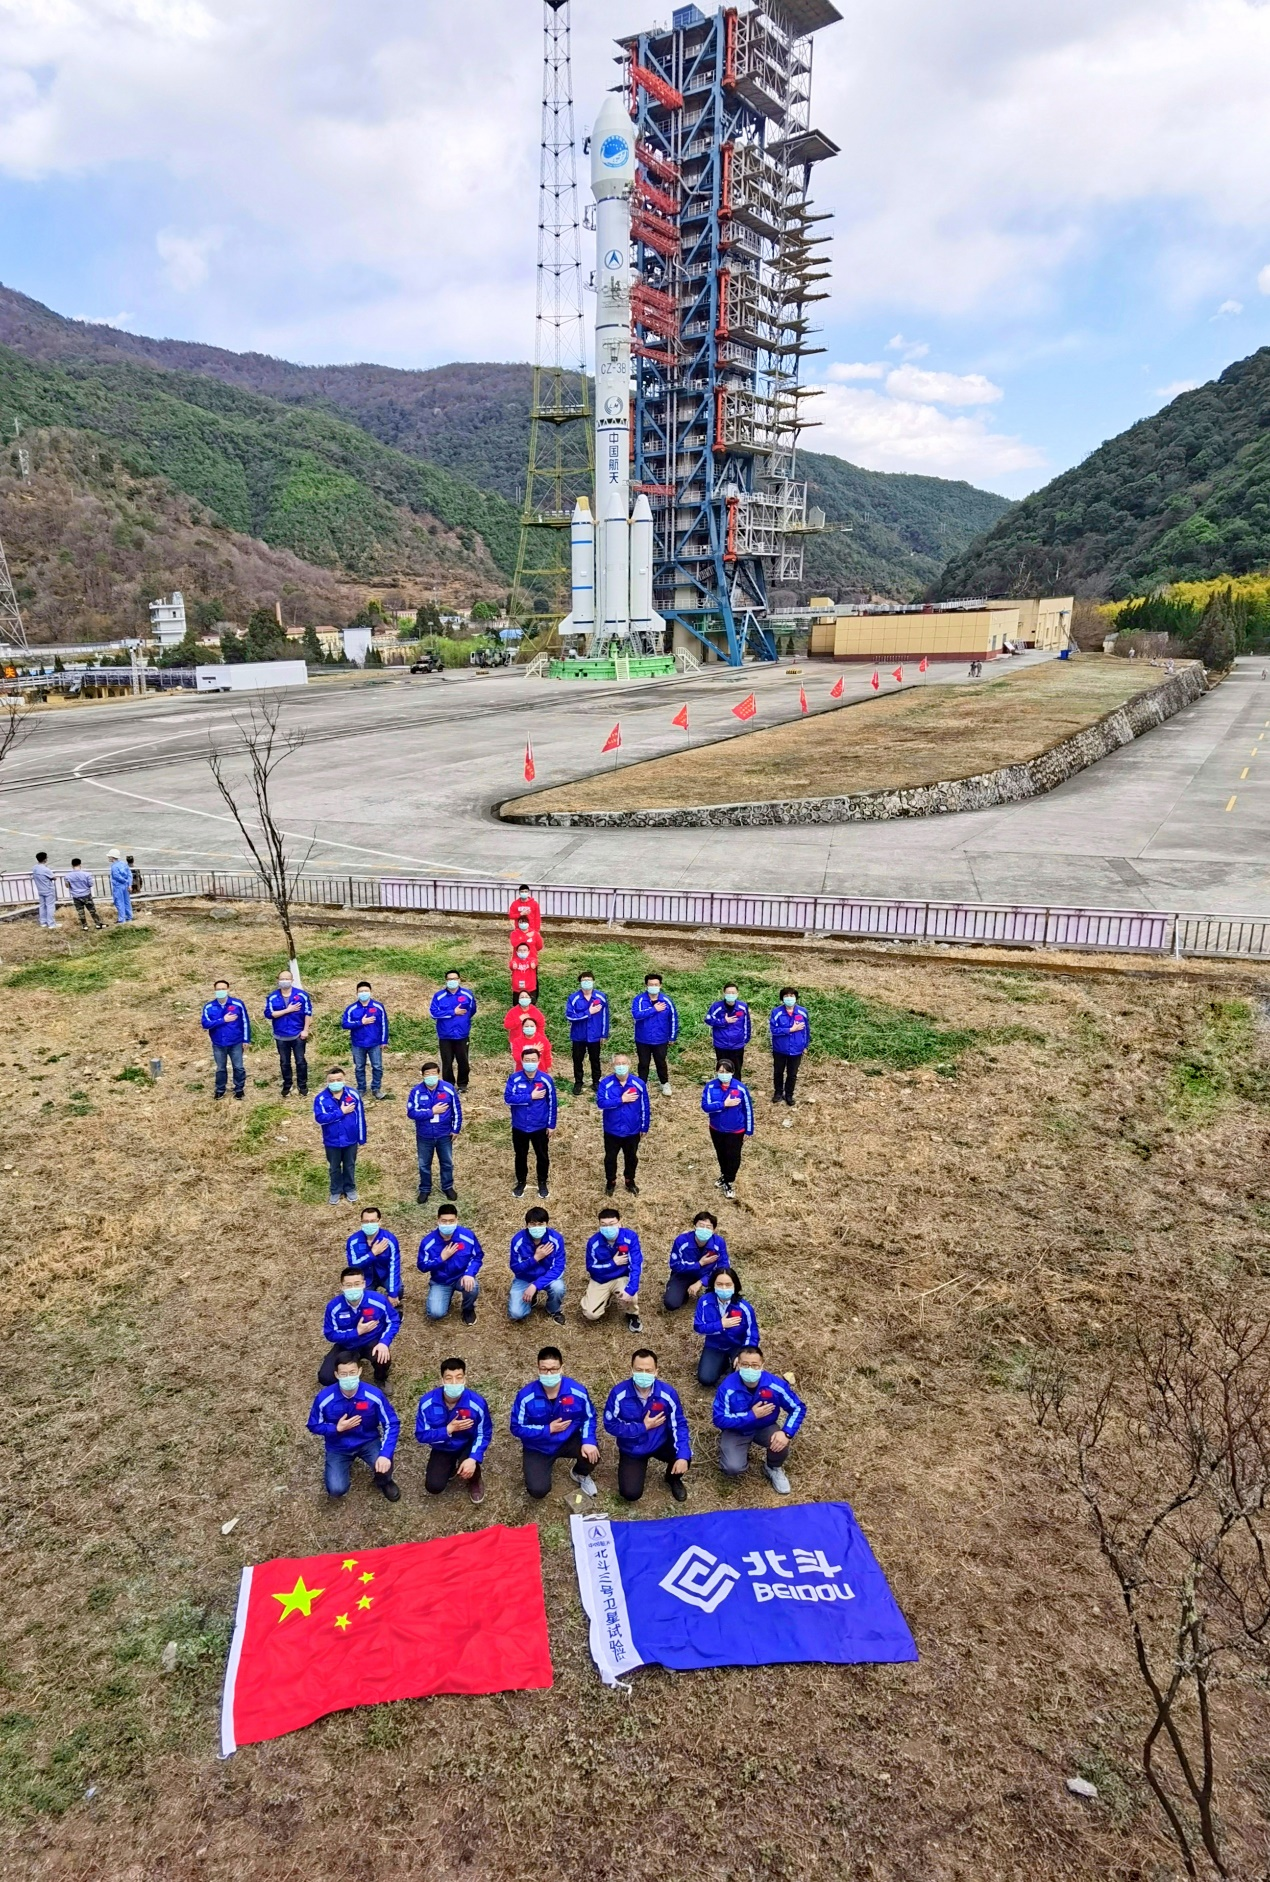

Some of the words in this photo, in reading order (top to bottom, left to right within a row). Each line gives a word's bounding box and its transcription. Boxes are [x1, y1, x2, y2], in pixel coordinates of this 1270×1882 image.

[601, 362, 627, 375] CZ-3B
[608, 432, 619, 484] 中国航天
[741, 1548, 843, 1578] 北斗
[752, 1582, 856, 1603] BEIDOU
